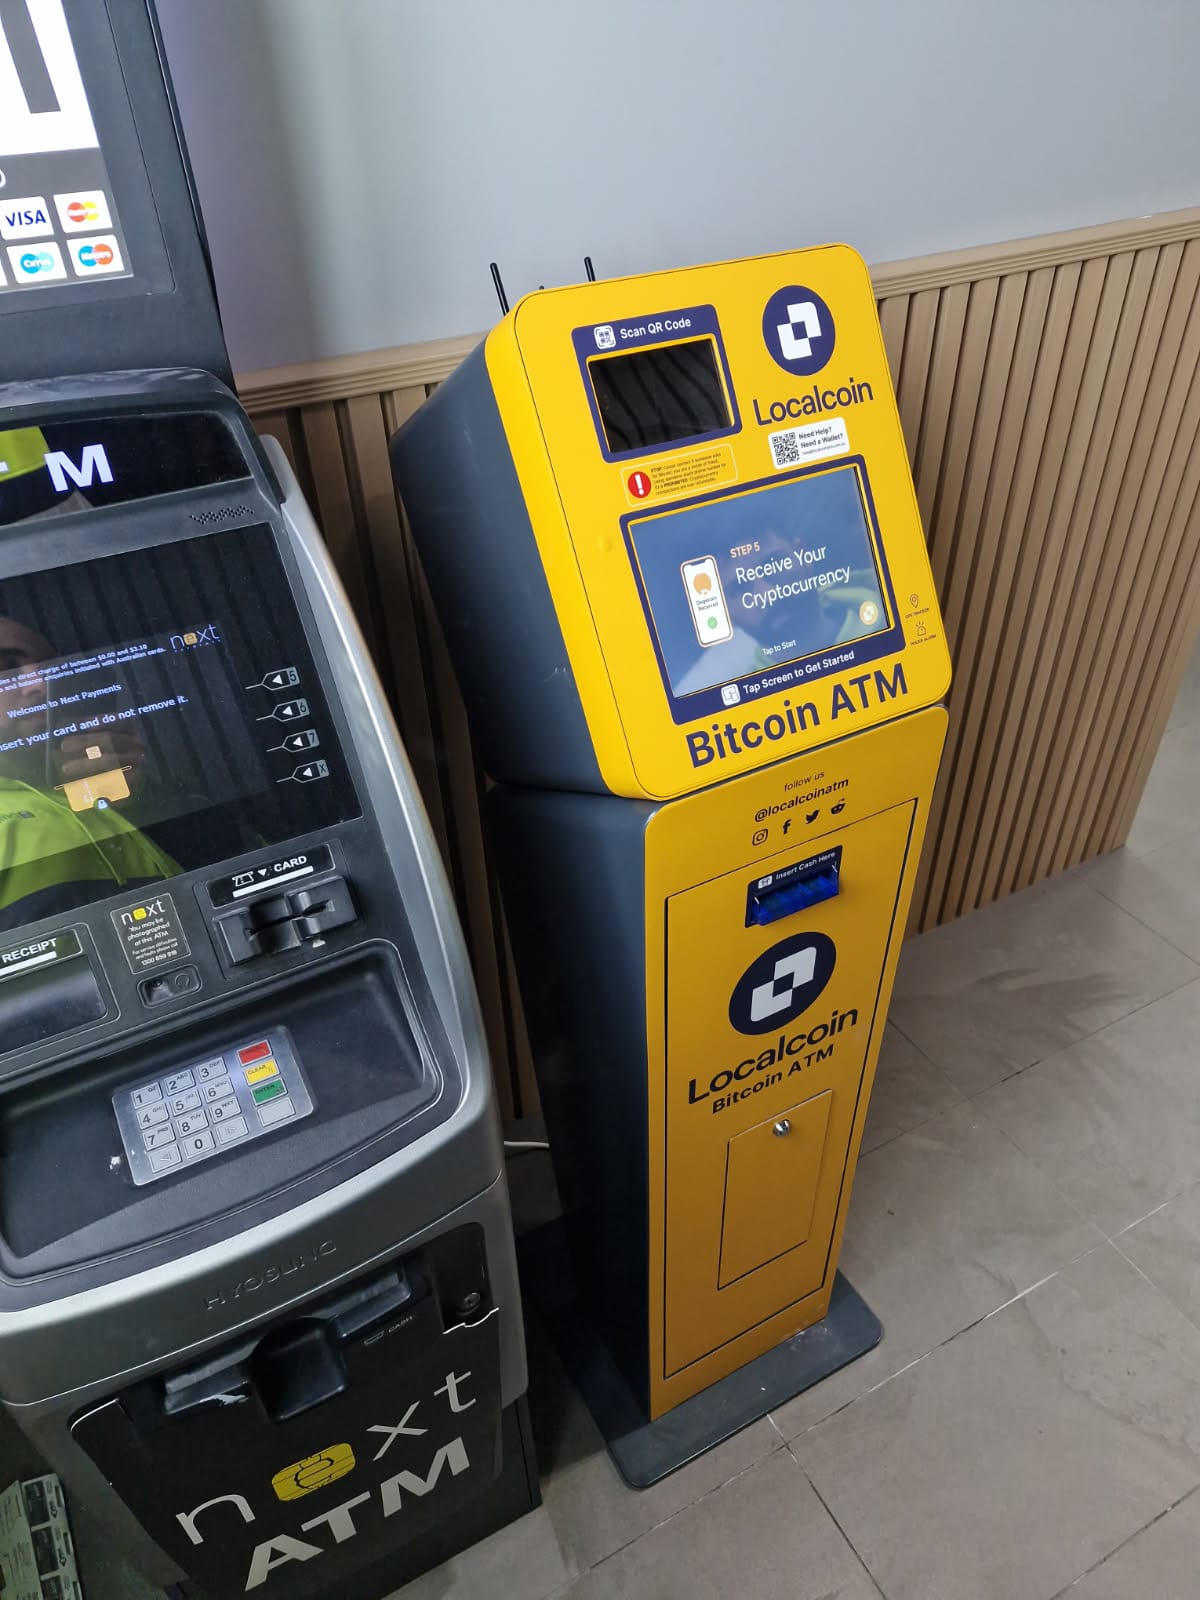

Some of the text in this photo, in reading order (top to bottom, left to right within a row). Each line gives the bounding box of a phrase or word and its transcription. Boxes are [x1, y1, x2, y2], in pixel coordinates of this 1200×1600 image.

[5, 210, 46, 227] VISA
[620, 316, 692, 340] Scan QR Code
[753, 377, 874, 426] Localcoin
[799, 427, 832, 439] Need Help?
[801, 440, 817, 449] Need
[822, 433, 843, 444] Wallet?
[0, 443, 113, 492] M
[730, 542, 761, 559] STEP 5
[735, 546, 827, 584] Receive Your
[742, 566, 850, 609] Cryptocurrency
[762, 647, 774, 657] Tap
[781, 639, 796, 650] Start
[61, 662, 68, 670] of
[69, 657, 97, 668] between
[289, 670, 297, 682] 5
[743, 650, 855, 695] Tap Screen to Get Started
[7, 703, 48, 718] Welcome
[60, 694, 81, 705] Next
[81, 684, 122, 700] Payments
[300, 702, 307, 713] 6
[26, 731, 50, 746] your
[53, 723, 77, 737] card
[80, 716, 100, 730] and
[102, 714, 116, 724] do
[118, 707, 136, 720] not
[138, 698, 175, 715] remove
[177, 695, 189, 704] it.
[685, 662, 908, 768] Bitcoin ATM
[308, 732, 315, 743] 7
[784, 772, 825, 792] follow us
[755, 779, 849, 822] @localcoinatm
[273, 855, 308, 873] CARD
[776, 852, 836, 880] Insert Cash Here
[121, 900, 165, 926] next
[128, 921, 170, 941] photographed
[142, 921, 155, 929] may
[154, 930, 169, 940] ATM
[1, 937, 58, 964] RECEIPT
[688, 1008, 858, 1105] Localcoin
[200, 1067, 210, 1078] 3
[247, 1064, 266, 1075] CLEAR
[168, 1080, 177, 1091] 2
[712, 1043, 834, 1114] Bitcoin ATM
[136, 1094, 143, 1104] 1
[208, 1087, 217, 1098] 6
[175, 1100, 184, 1111] 5
[214, 1108, 223, 1119] 9
[142, 1114, 151, 1123] 4
[181, 1121, 191, 1133] 8
[147, 1134, 156, 1146] 7
[194, 1138, 203, 1150] 0
[176, 1370, 478, 1545] next
[245, 1436, 472, 1592] ATM
